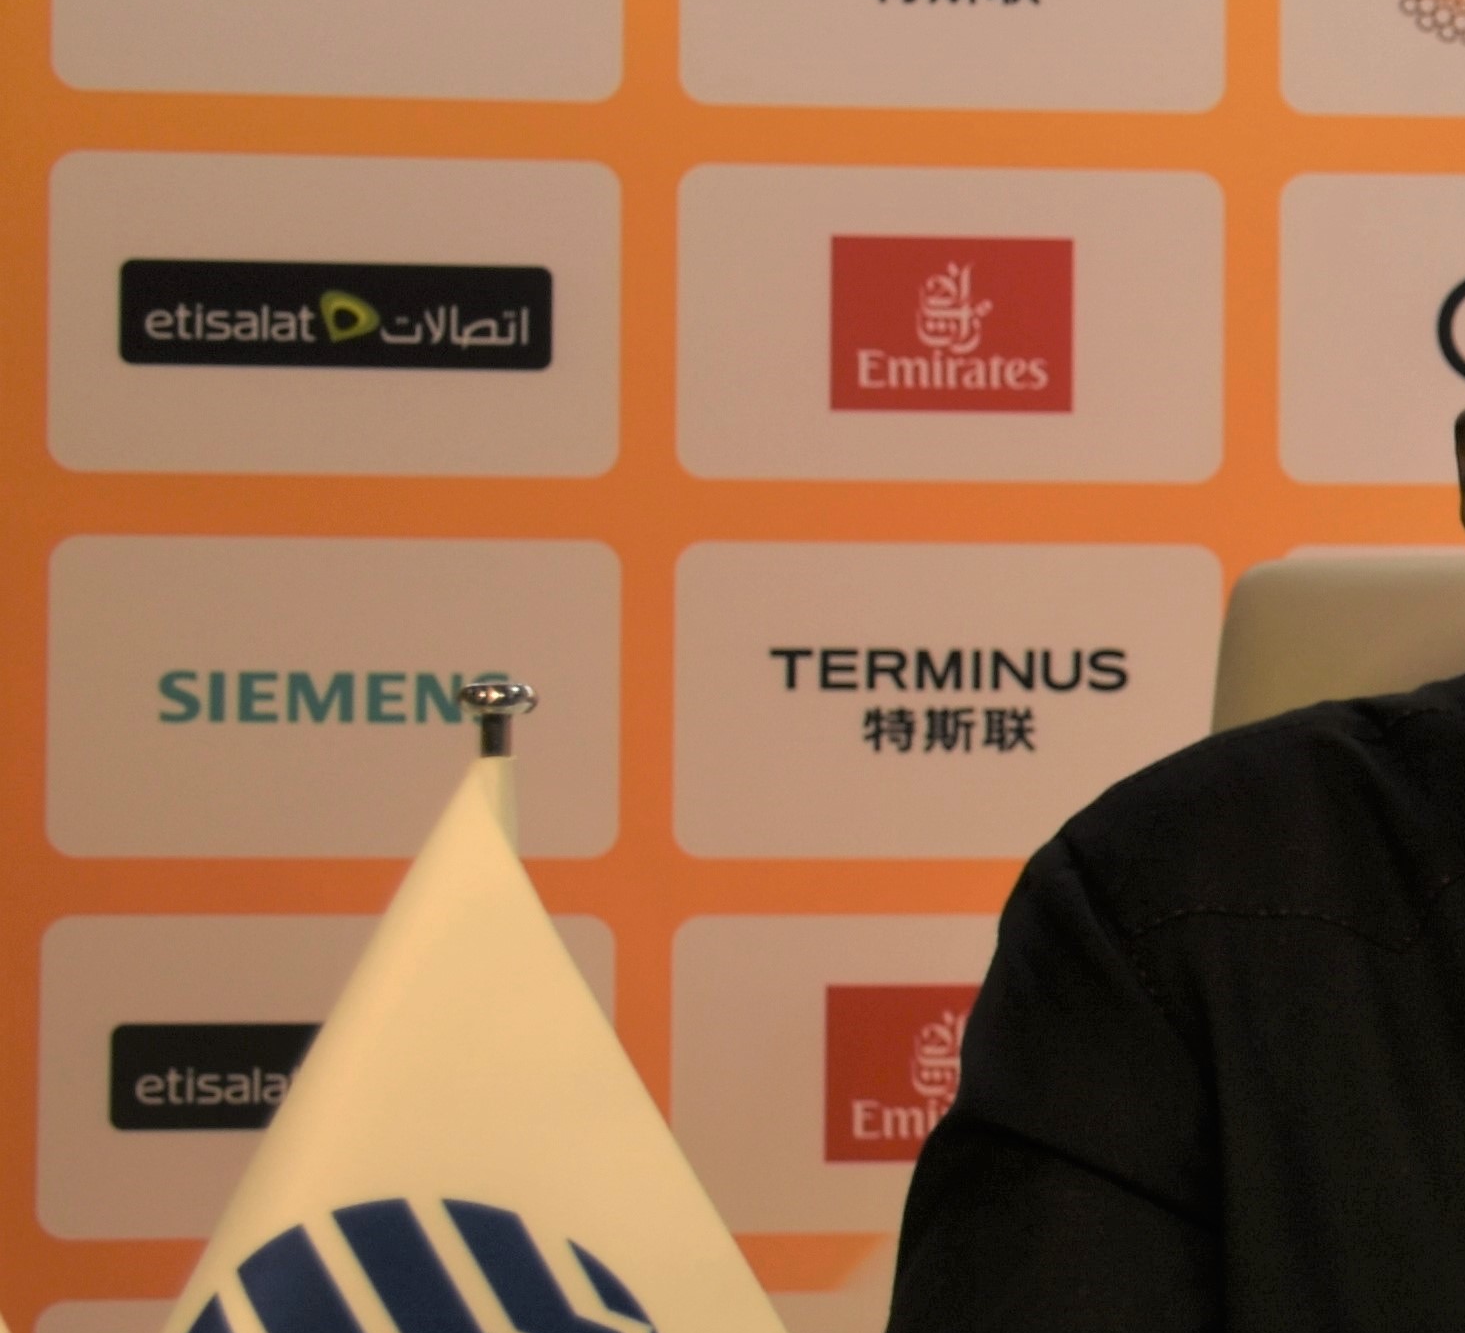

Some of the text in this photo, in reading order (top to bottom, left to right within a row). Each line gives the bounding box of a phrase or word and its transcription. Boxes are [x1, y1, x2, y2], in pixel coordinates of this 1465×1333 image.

[144, 304, 315, 342] etisalat
[378, 306, 529, 348] اتصالات
[858, 348, 1048, 389] Emirates
[770, 649, 1128, 692] TERMINUS
[158, 670, 510, 724] SIEMEN
[864, 708, 1034, 752] 特斯联
[135, 1067, 288, 1106] etisala
